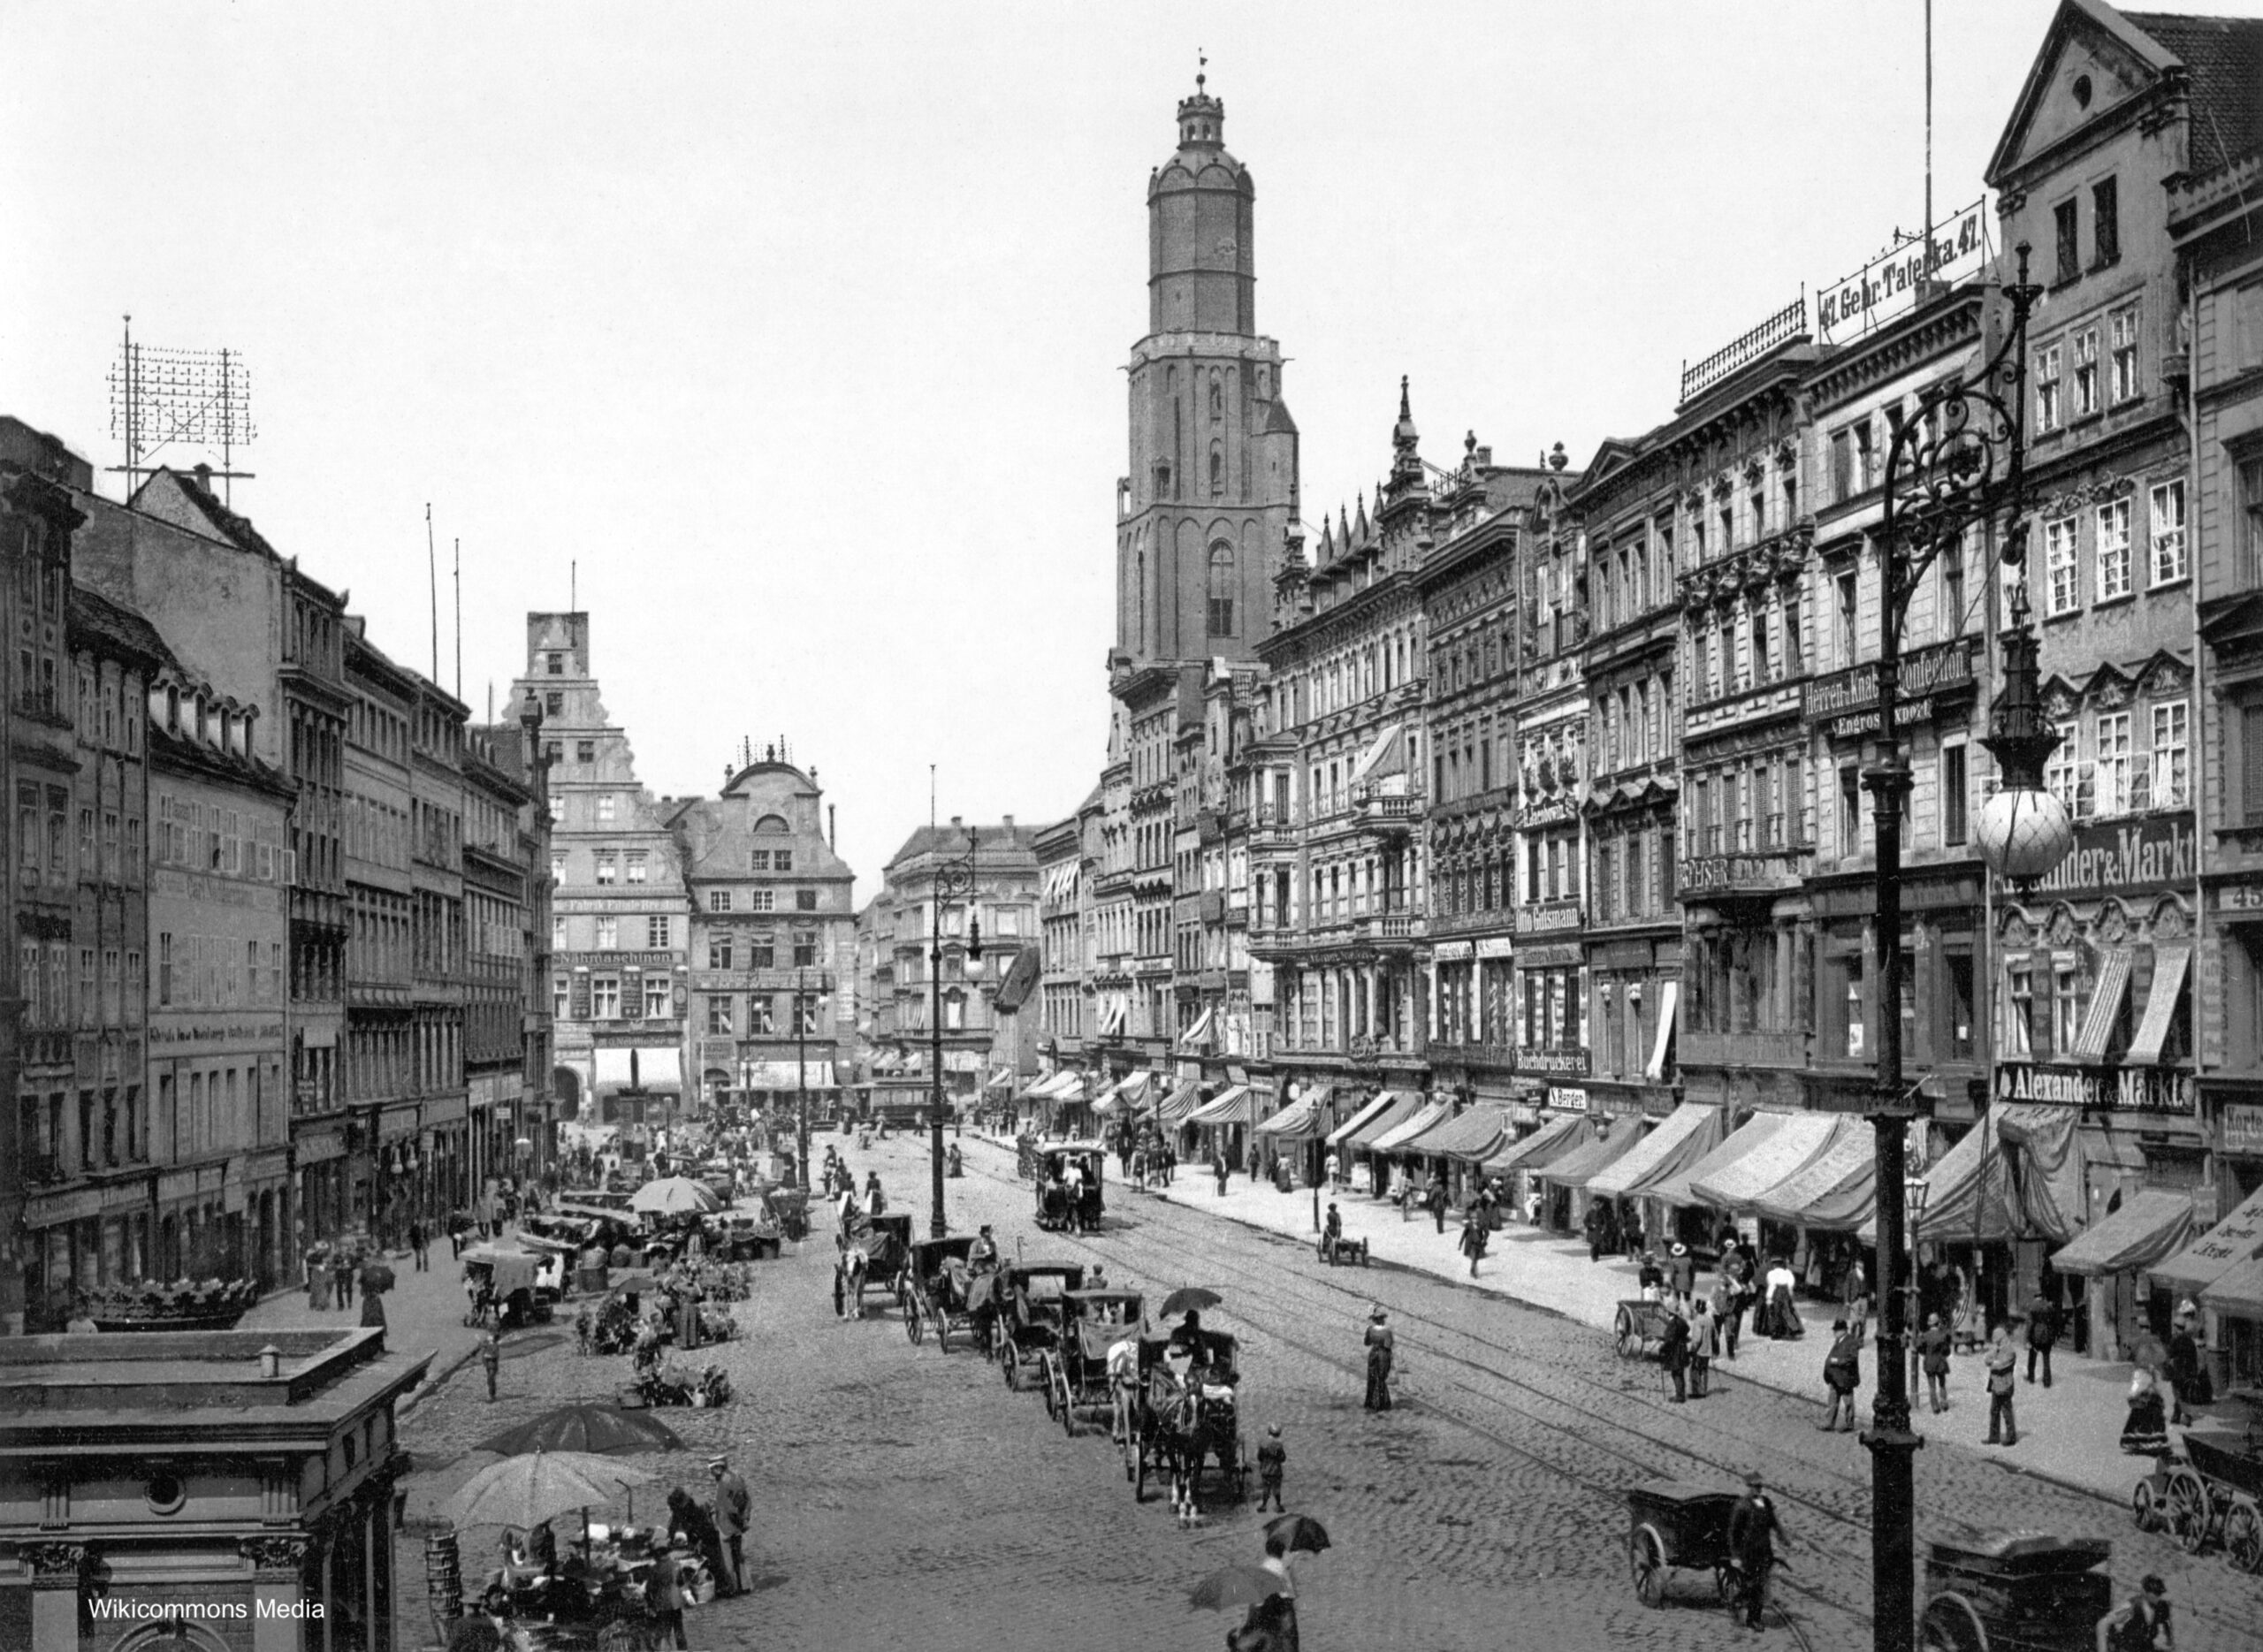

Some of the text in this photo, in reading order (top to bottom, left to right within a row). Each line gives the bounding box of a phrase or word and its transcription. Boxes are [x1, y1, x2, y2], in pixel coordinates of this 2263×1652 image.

[1957, 213, 1981, 255] 47.
[1516, 908, 1533, 933] Otto
[1517, 1050, 1587, 1071] Buchdruckerei
[2013, 1067, 2101, 1103] Alexander
